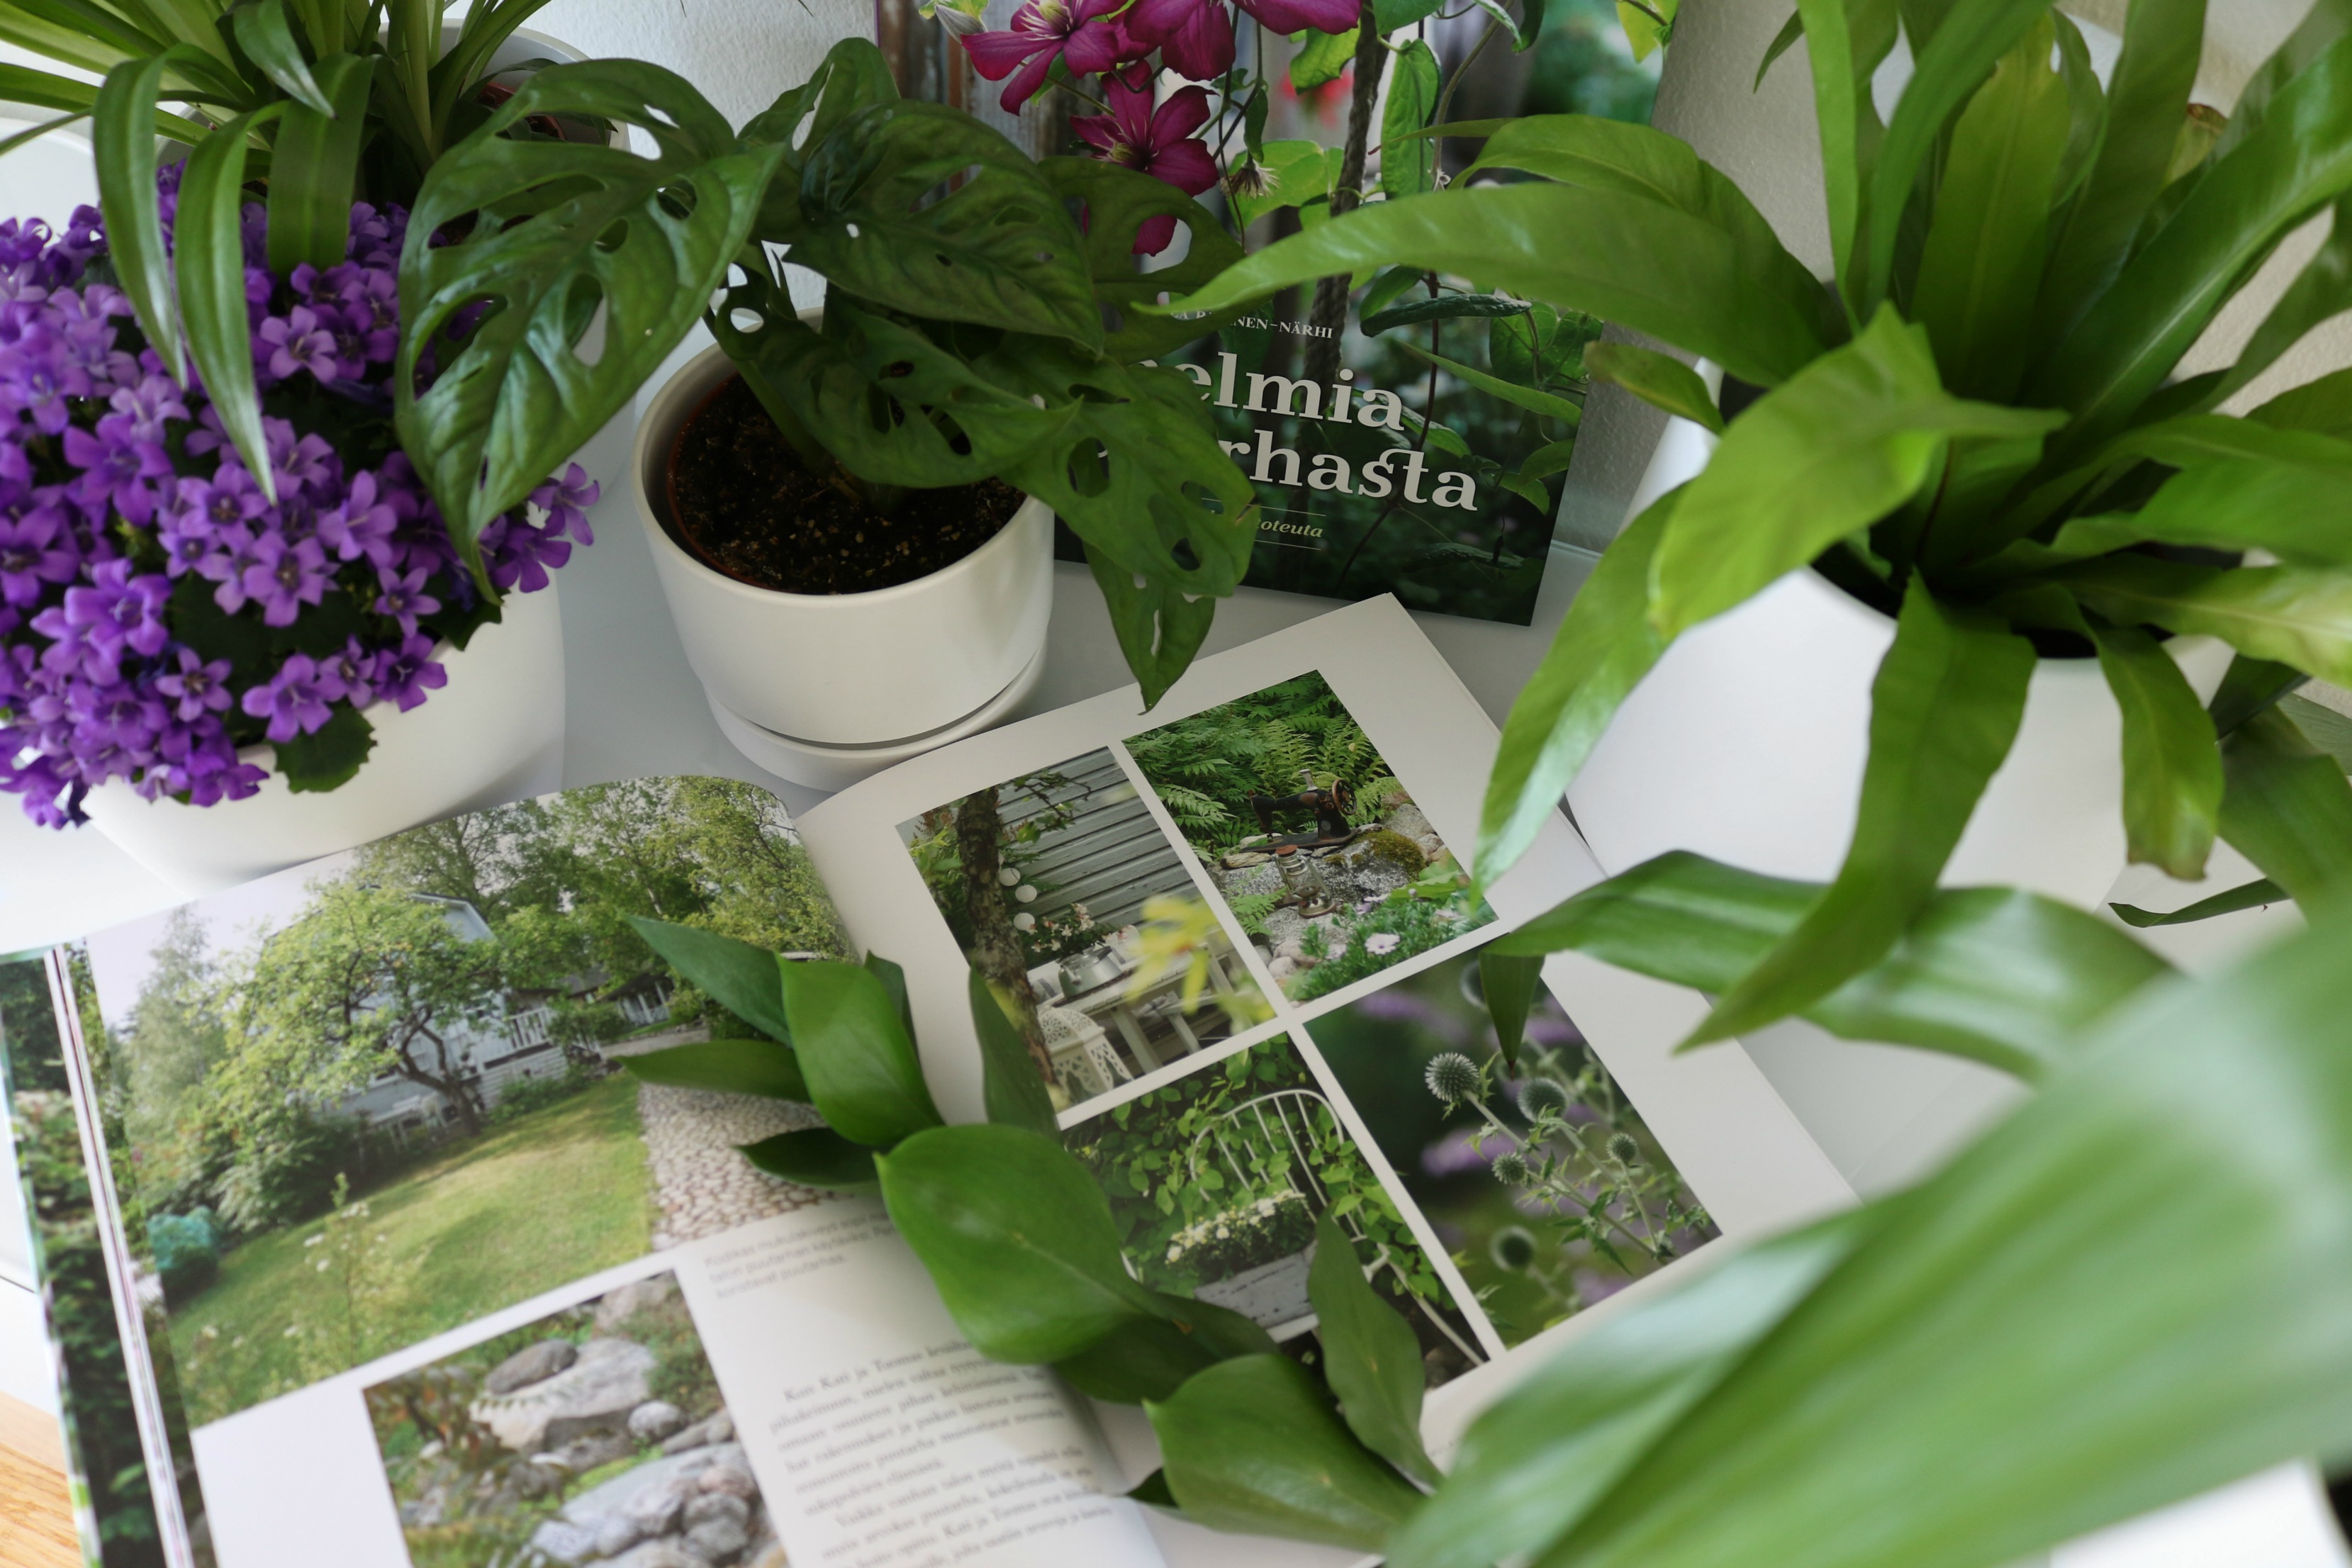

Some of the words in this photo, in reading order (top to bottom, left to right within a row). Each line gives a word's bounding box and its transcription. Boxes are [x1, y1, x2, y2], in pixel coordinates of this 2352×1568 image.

[1130, 351, 1405, 432] elmia
[855, 1368, 868, 1382] ja
[899, 1423, 911, 1435] ja
[977, 1517, 988, 1529] ja
[1070, 1514, 1079, 1523] ja
